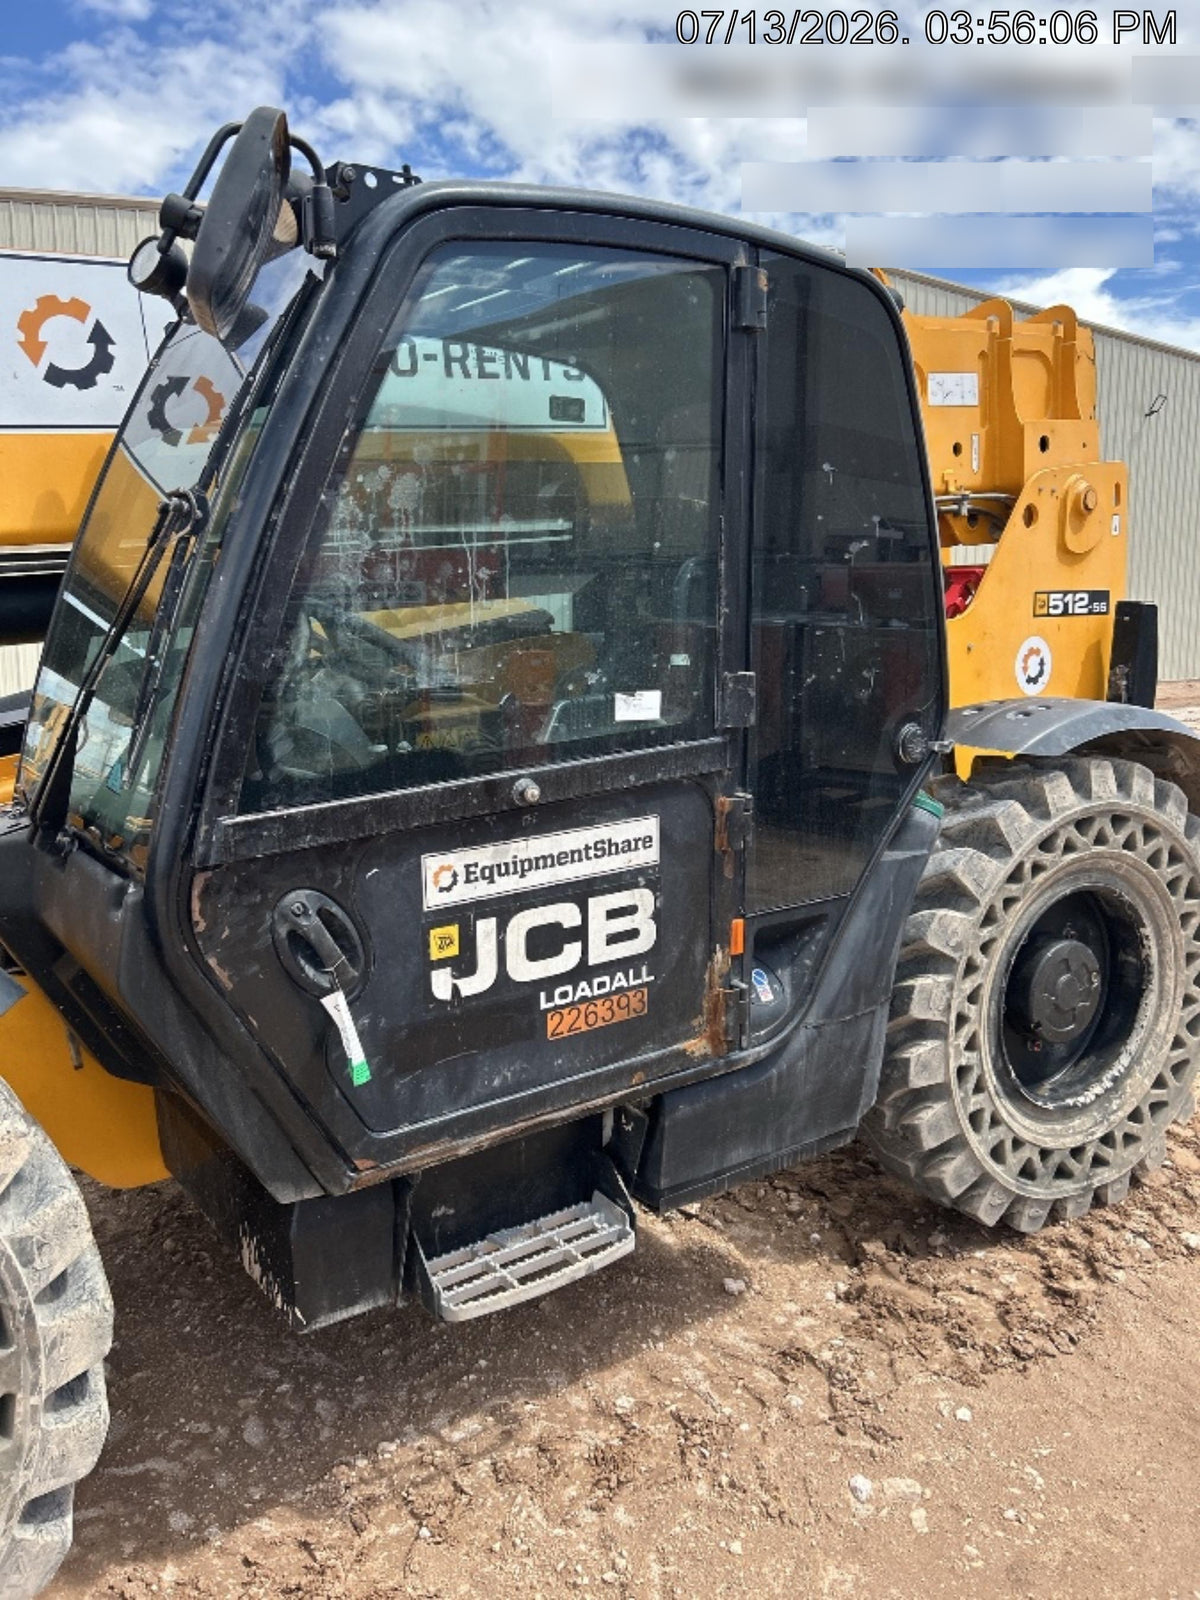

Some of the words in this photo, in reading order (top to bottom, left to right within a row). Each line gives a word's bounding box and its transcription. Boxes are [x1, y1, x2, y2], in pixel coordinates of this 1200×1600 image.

[463, 834, 654, 885] EquipmentShare
[430, 887, 658, 1001] JCB
[539, 964, 656, 1010] LOADALL
[550, 989, 646, 1037] 226393
